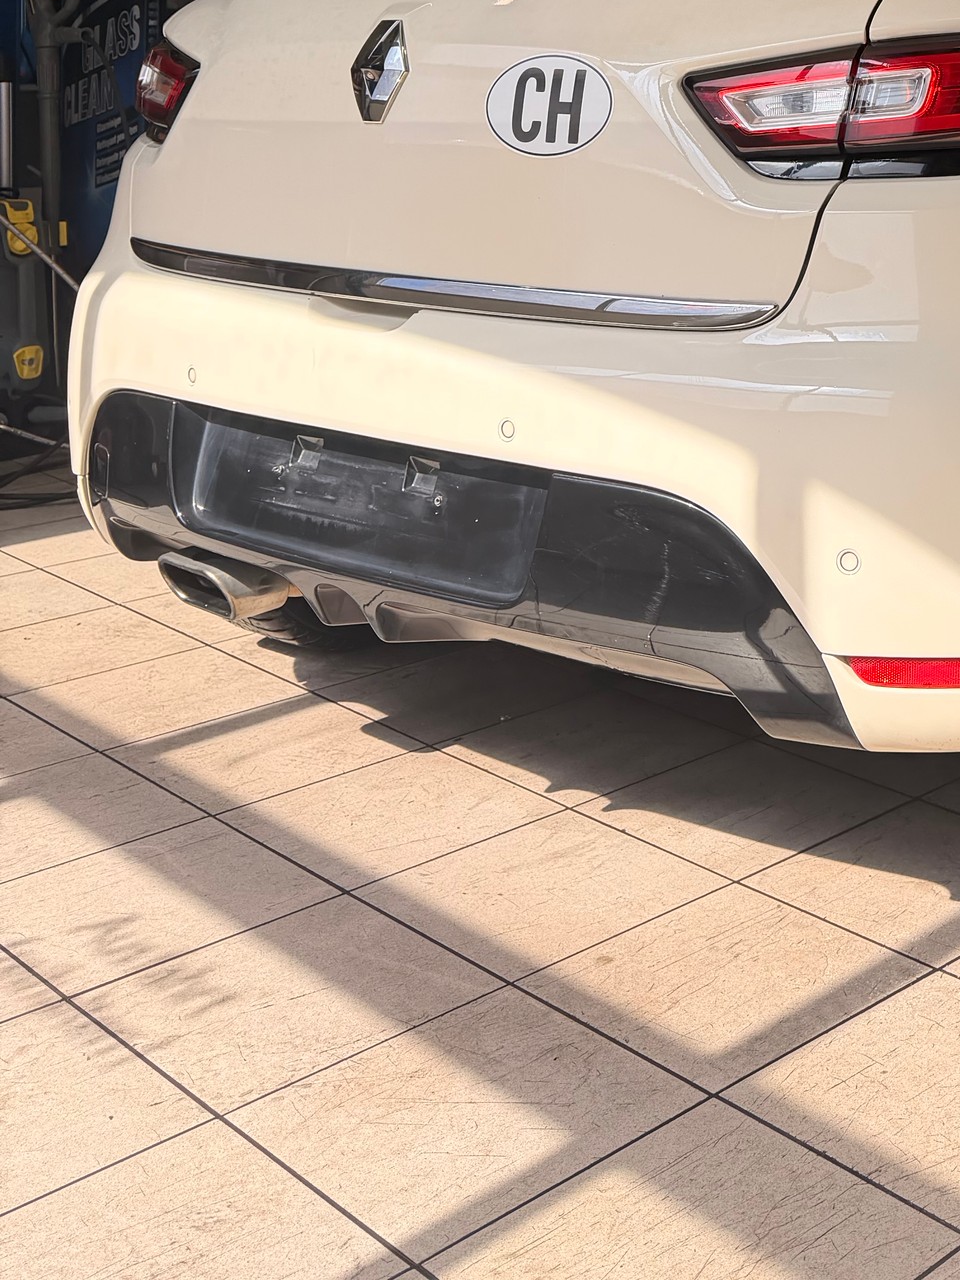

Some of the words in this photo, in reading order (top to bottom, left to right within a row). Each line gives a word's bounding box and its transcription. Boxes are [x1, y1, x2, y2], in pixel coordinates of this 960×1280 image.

[82, 4, 141, 73] GLASS
[64, 65, 114, 128] CLEAN
[511, 67, 587, 144] CH
